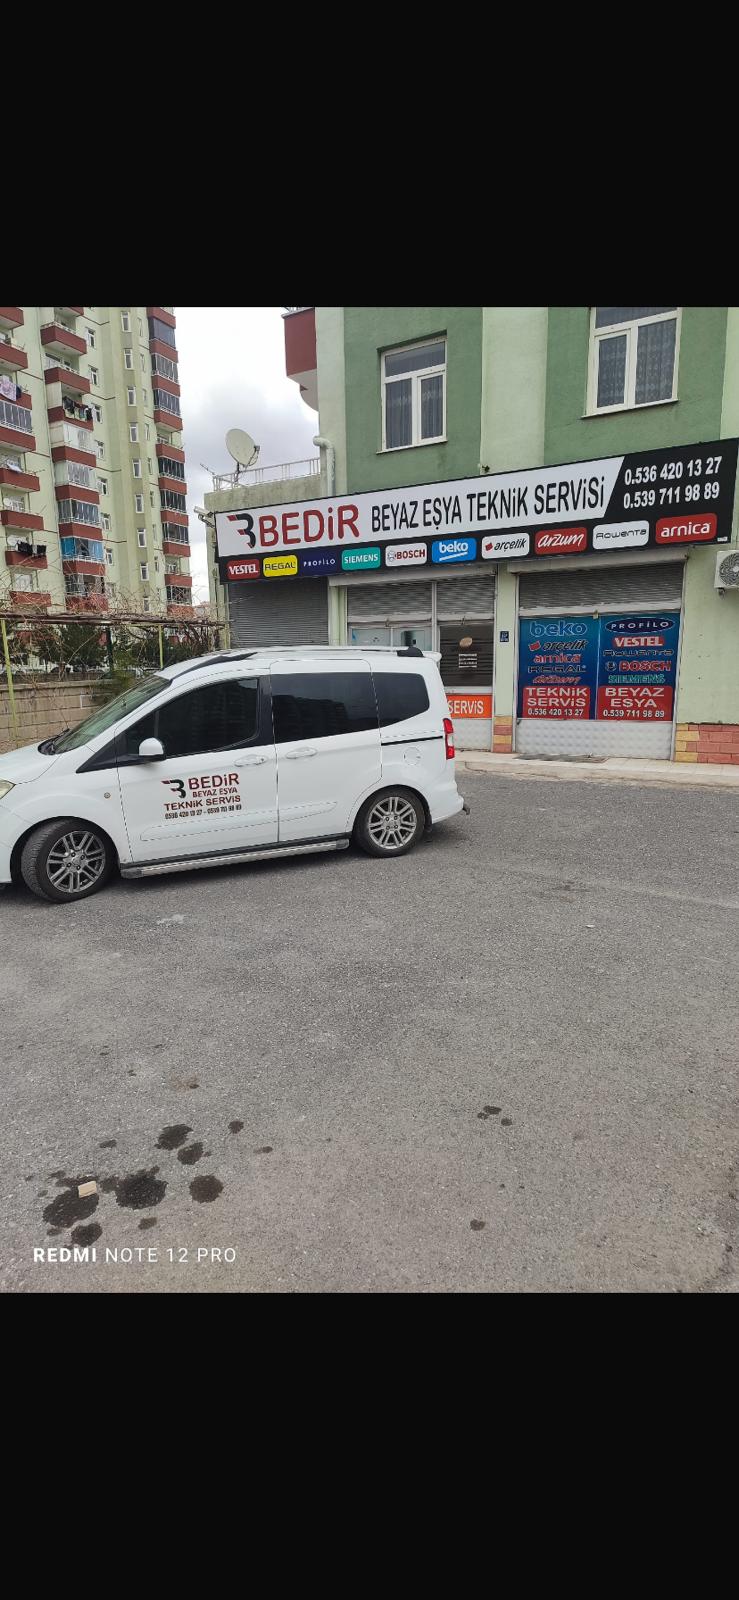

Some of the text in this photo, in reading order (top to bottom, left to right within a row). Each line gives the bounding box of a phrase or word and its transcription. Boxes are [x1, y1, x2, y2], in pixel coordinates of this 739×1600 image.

[624, 456, 722, 486] 0.536 420 13 27
[623, 482, 720, 508] 0.539 711 98 89
[372, 500, 419, 532] BEYAZ
[423, 495, 462, 530] EŞYA
[660, 522, 712, 538] arnica
[439, 540, 468, 554] beko
[494, 538, 526, 552] arçelik
[344, 553, 378, 564] SIEMENS
[396, 549, 426, 560] BOSCH
[228, 564, 258, 575] VESTEL
[264, 562, 296, 571] REGAL
[530, 620, 588, 637] beko
[614, 636, 664, 647] VESTEL
[534, 652, 582, 664] arnica
[618, 660, 672, 672] BOSCH
[608, 674, 665, 684] SIEMENS
[605, 688, 664, 697] BEYAZ
[192, 788, 218, 798] BEYAZ
